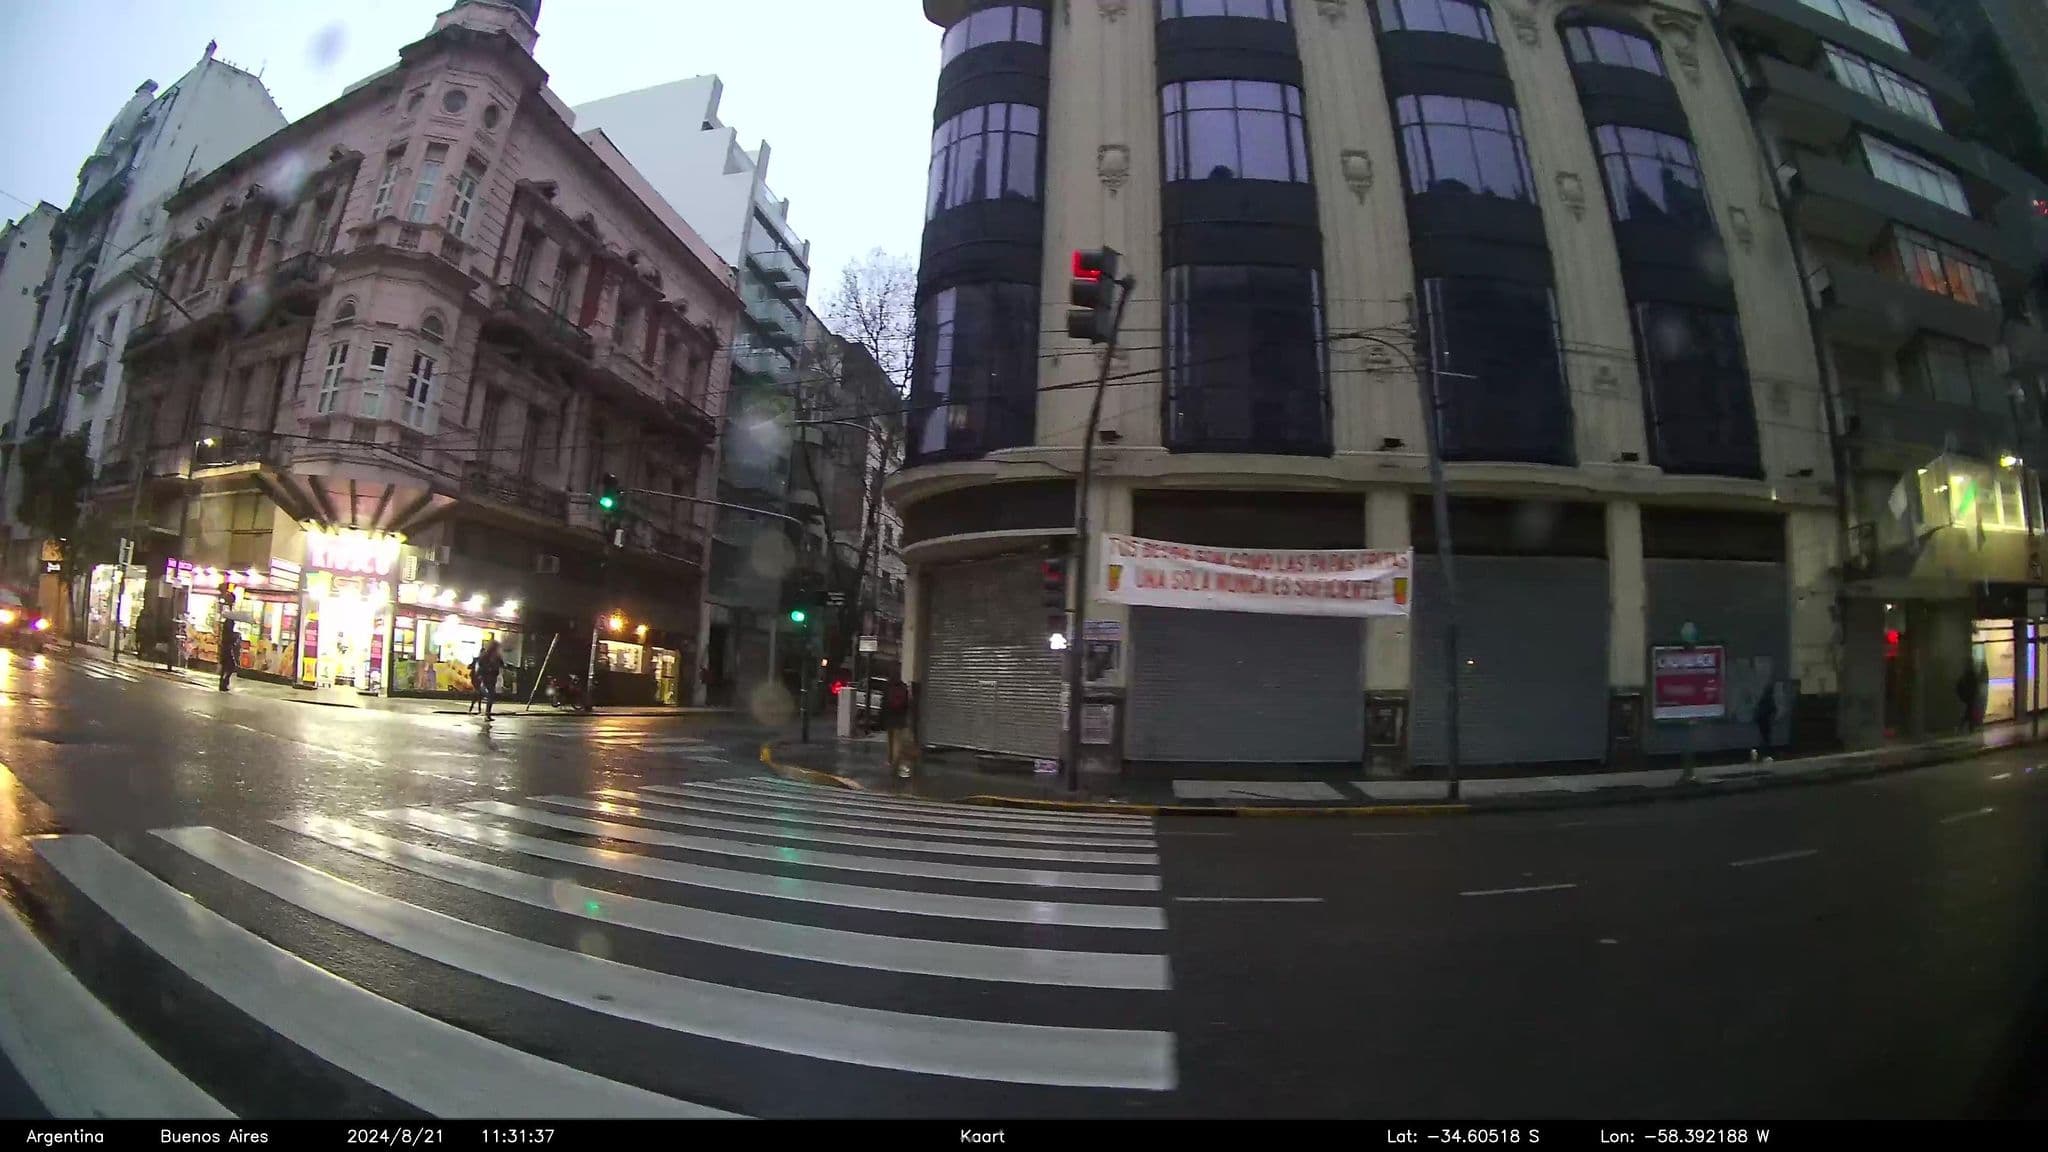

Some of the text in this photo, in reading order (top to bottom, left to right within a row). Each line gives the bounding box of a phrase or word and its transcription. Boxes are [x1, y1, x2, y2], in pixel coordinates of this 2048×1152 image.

[1229, 551, 1273, 572] COMO
[1277, 552, 1305, 573] LAS
[1136, 567, 1165, 589] UNA
[1172, 569, 1210, 591] SOLA
[1216, 571, 1266, 594] NUNCA
[1272, 575, 1291, 596] ES
